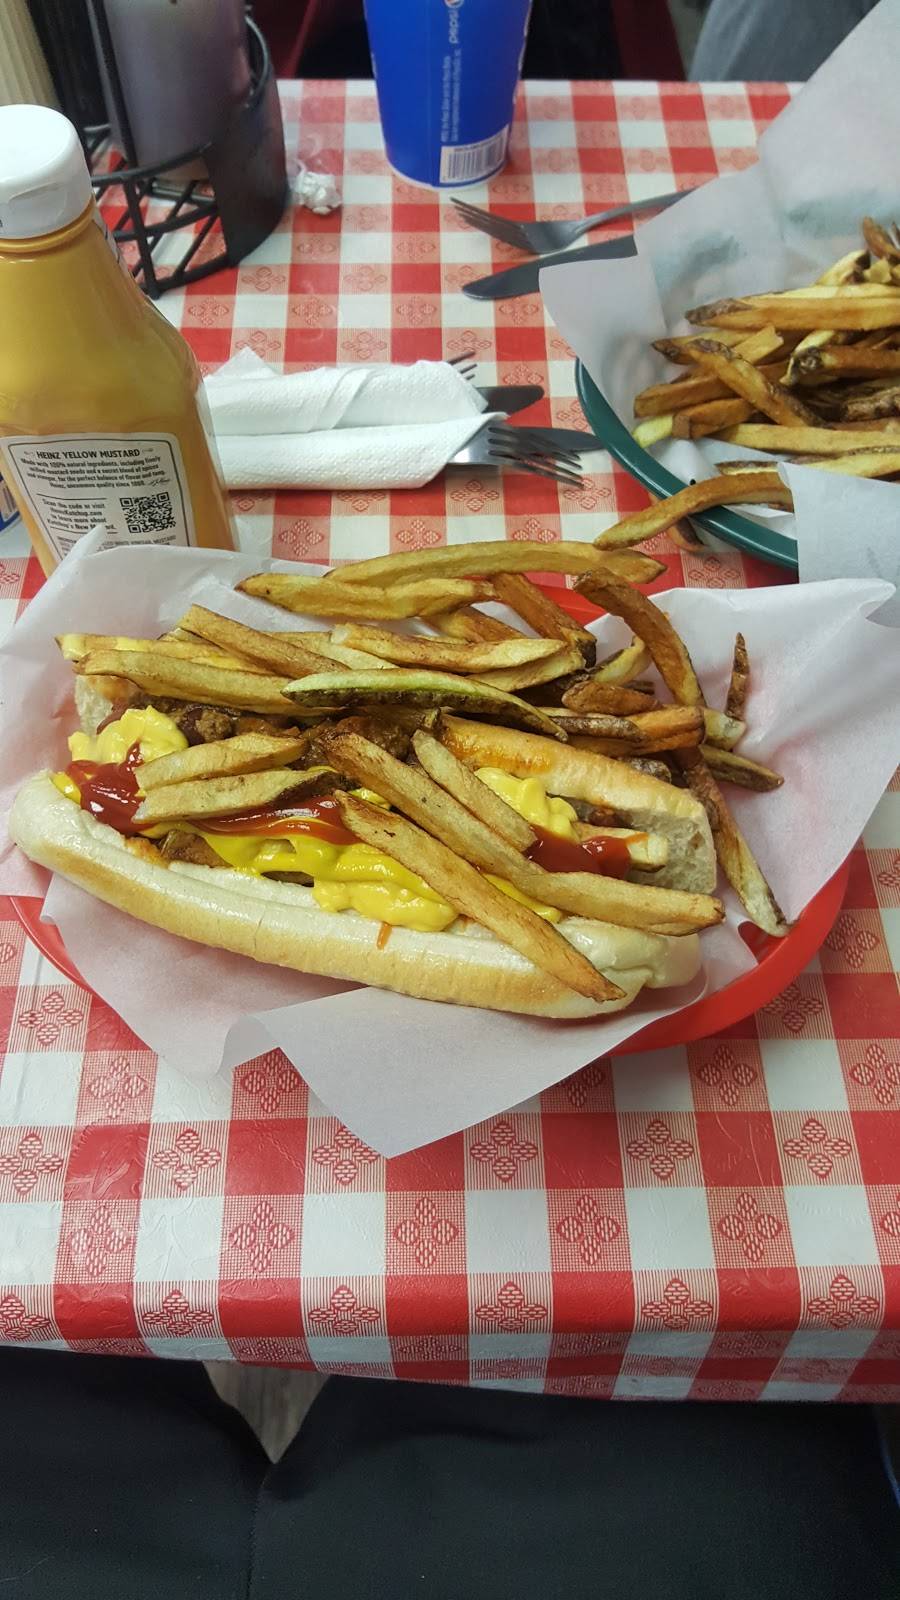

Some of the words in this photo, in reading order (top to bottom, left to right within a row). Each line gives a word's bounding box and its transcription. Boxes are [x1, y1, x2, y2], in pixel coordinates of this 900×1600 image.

[448, 9, 460, 44] pepsi
[36, 451, 61, 459] HEINZ
[62, 450, 97, 459] YELLOW
[100, 449, 140, 458] MUSTARD
